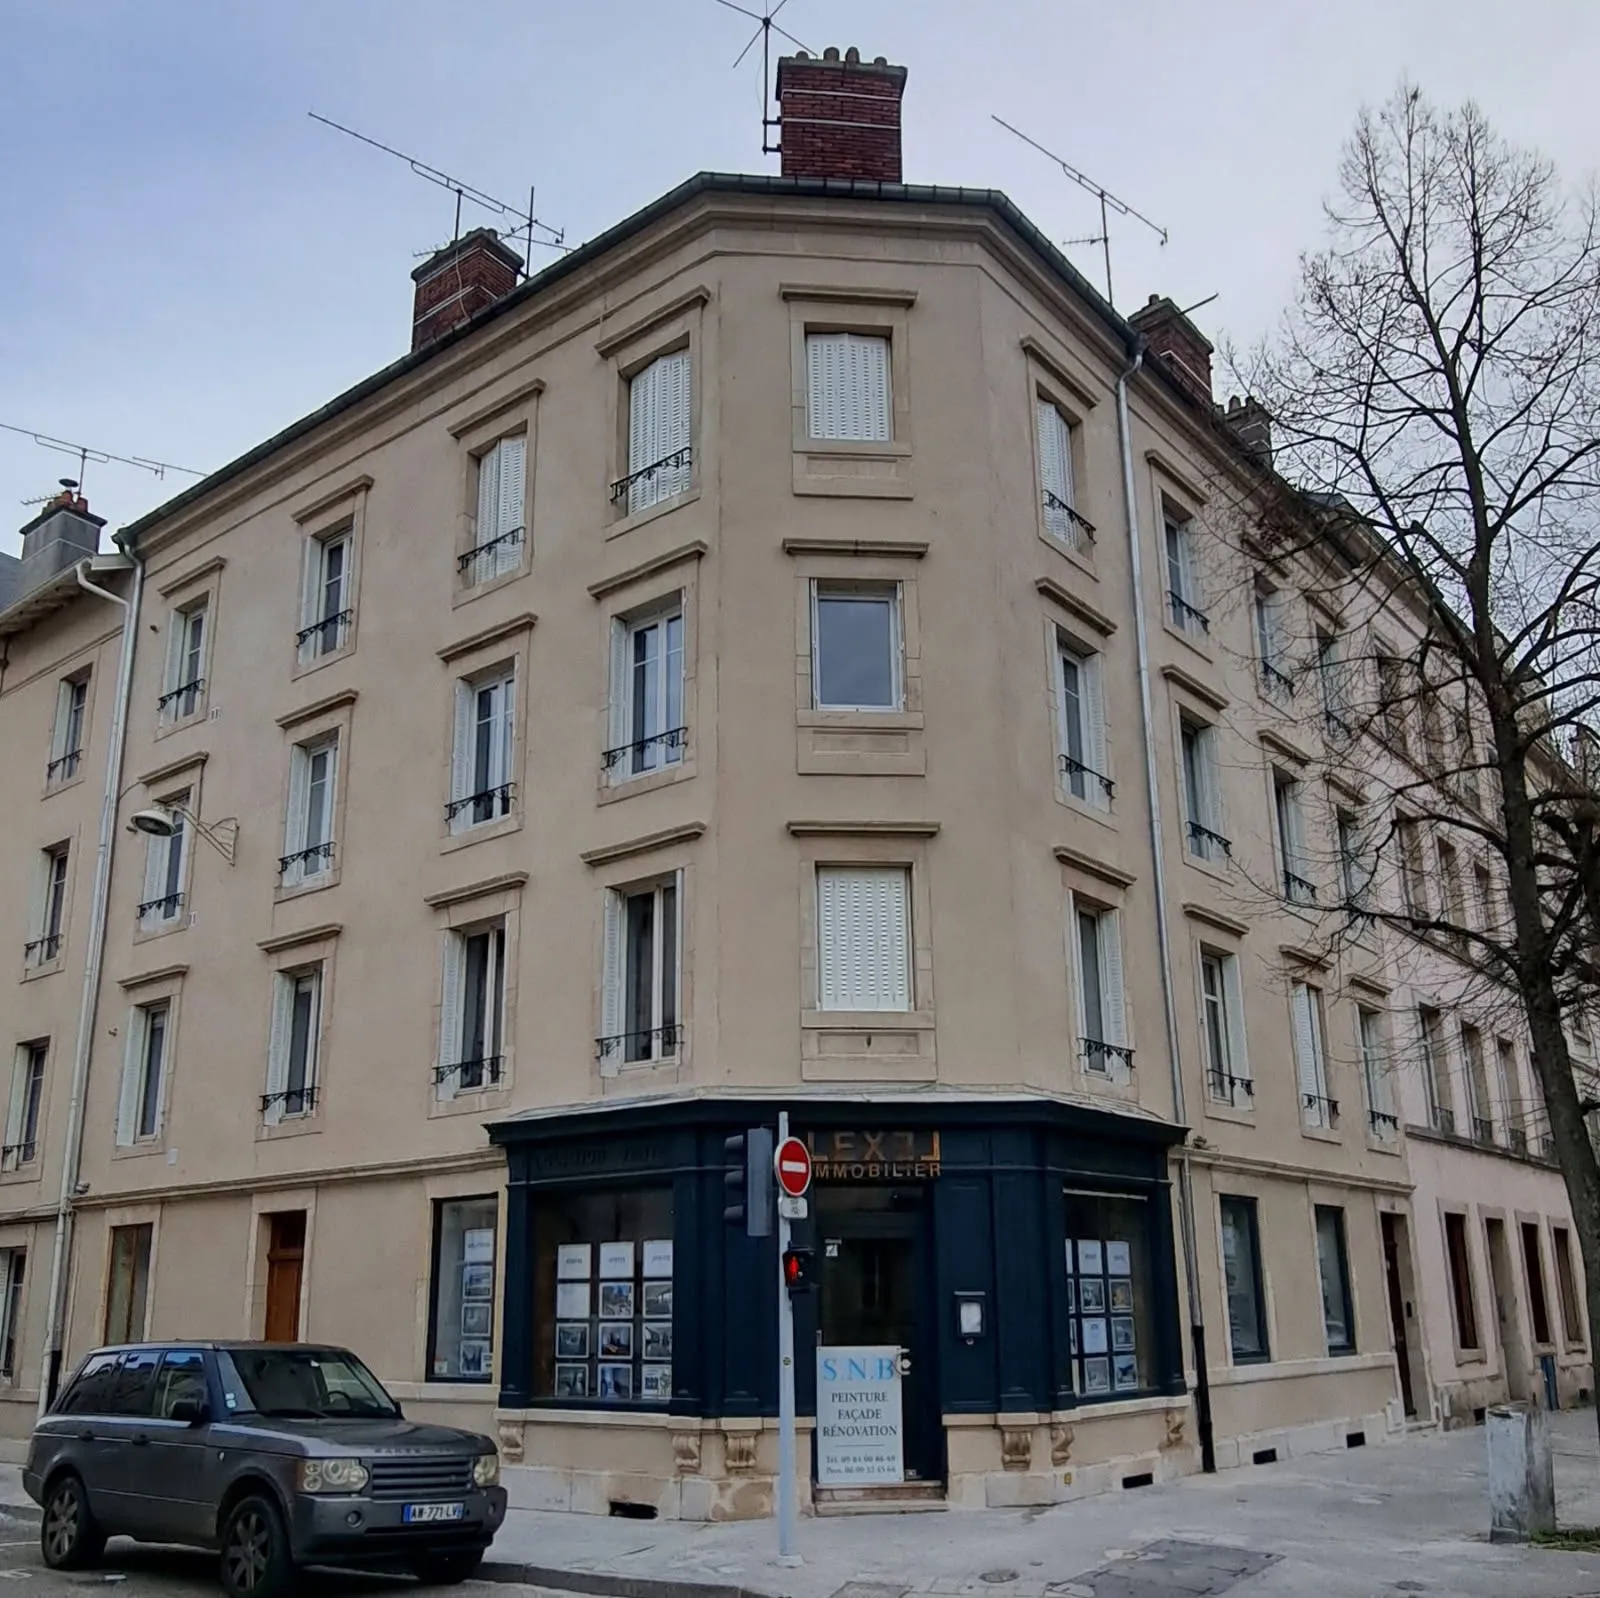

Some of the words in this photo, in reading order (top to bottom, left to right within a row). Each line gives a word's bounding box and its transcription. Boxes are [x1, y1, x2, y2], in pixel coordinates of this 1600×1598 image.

[815, 1163, 941, 1179] MMOBILIER
[831, 1391, 889, 1403] PEINTURE
[837, 1408, 882, 1422] FAÇADE
[822, 1425, 898, 1438] RÉNOVATION
